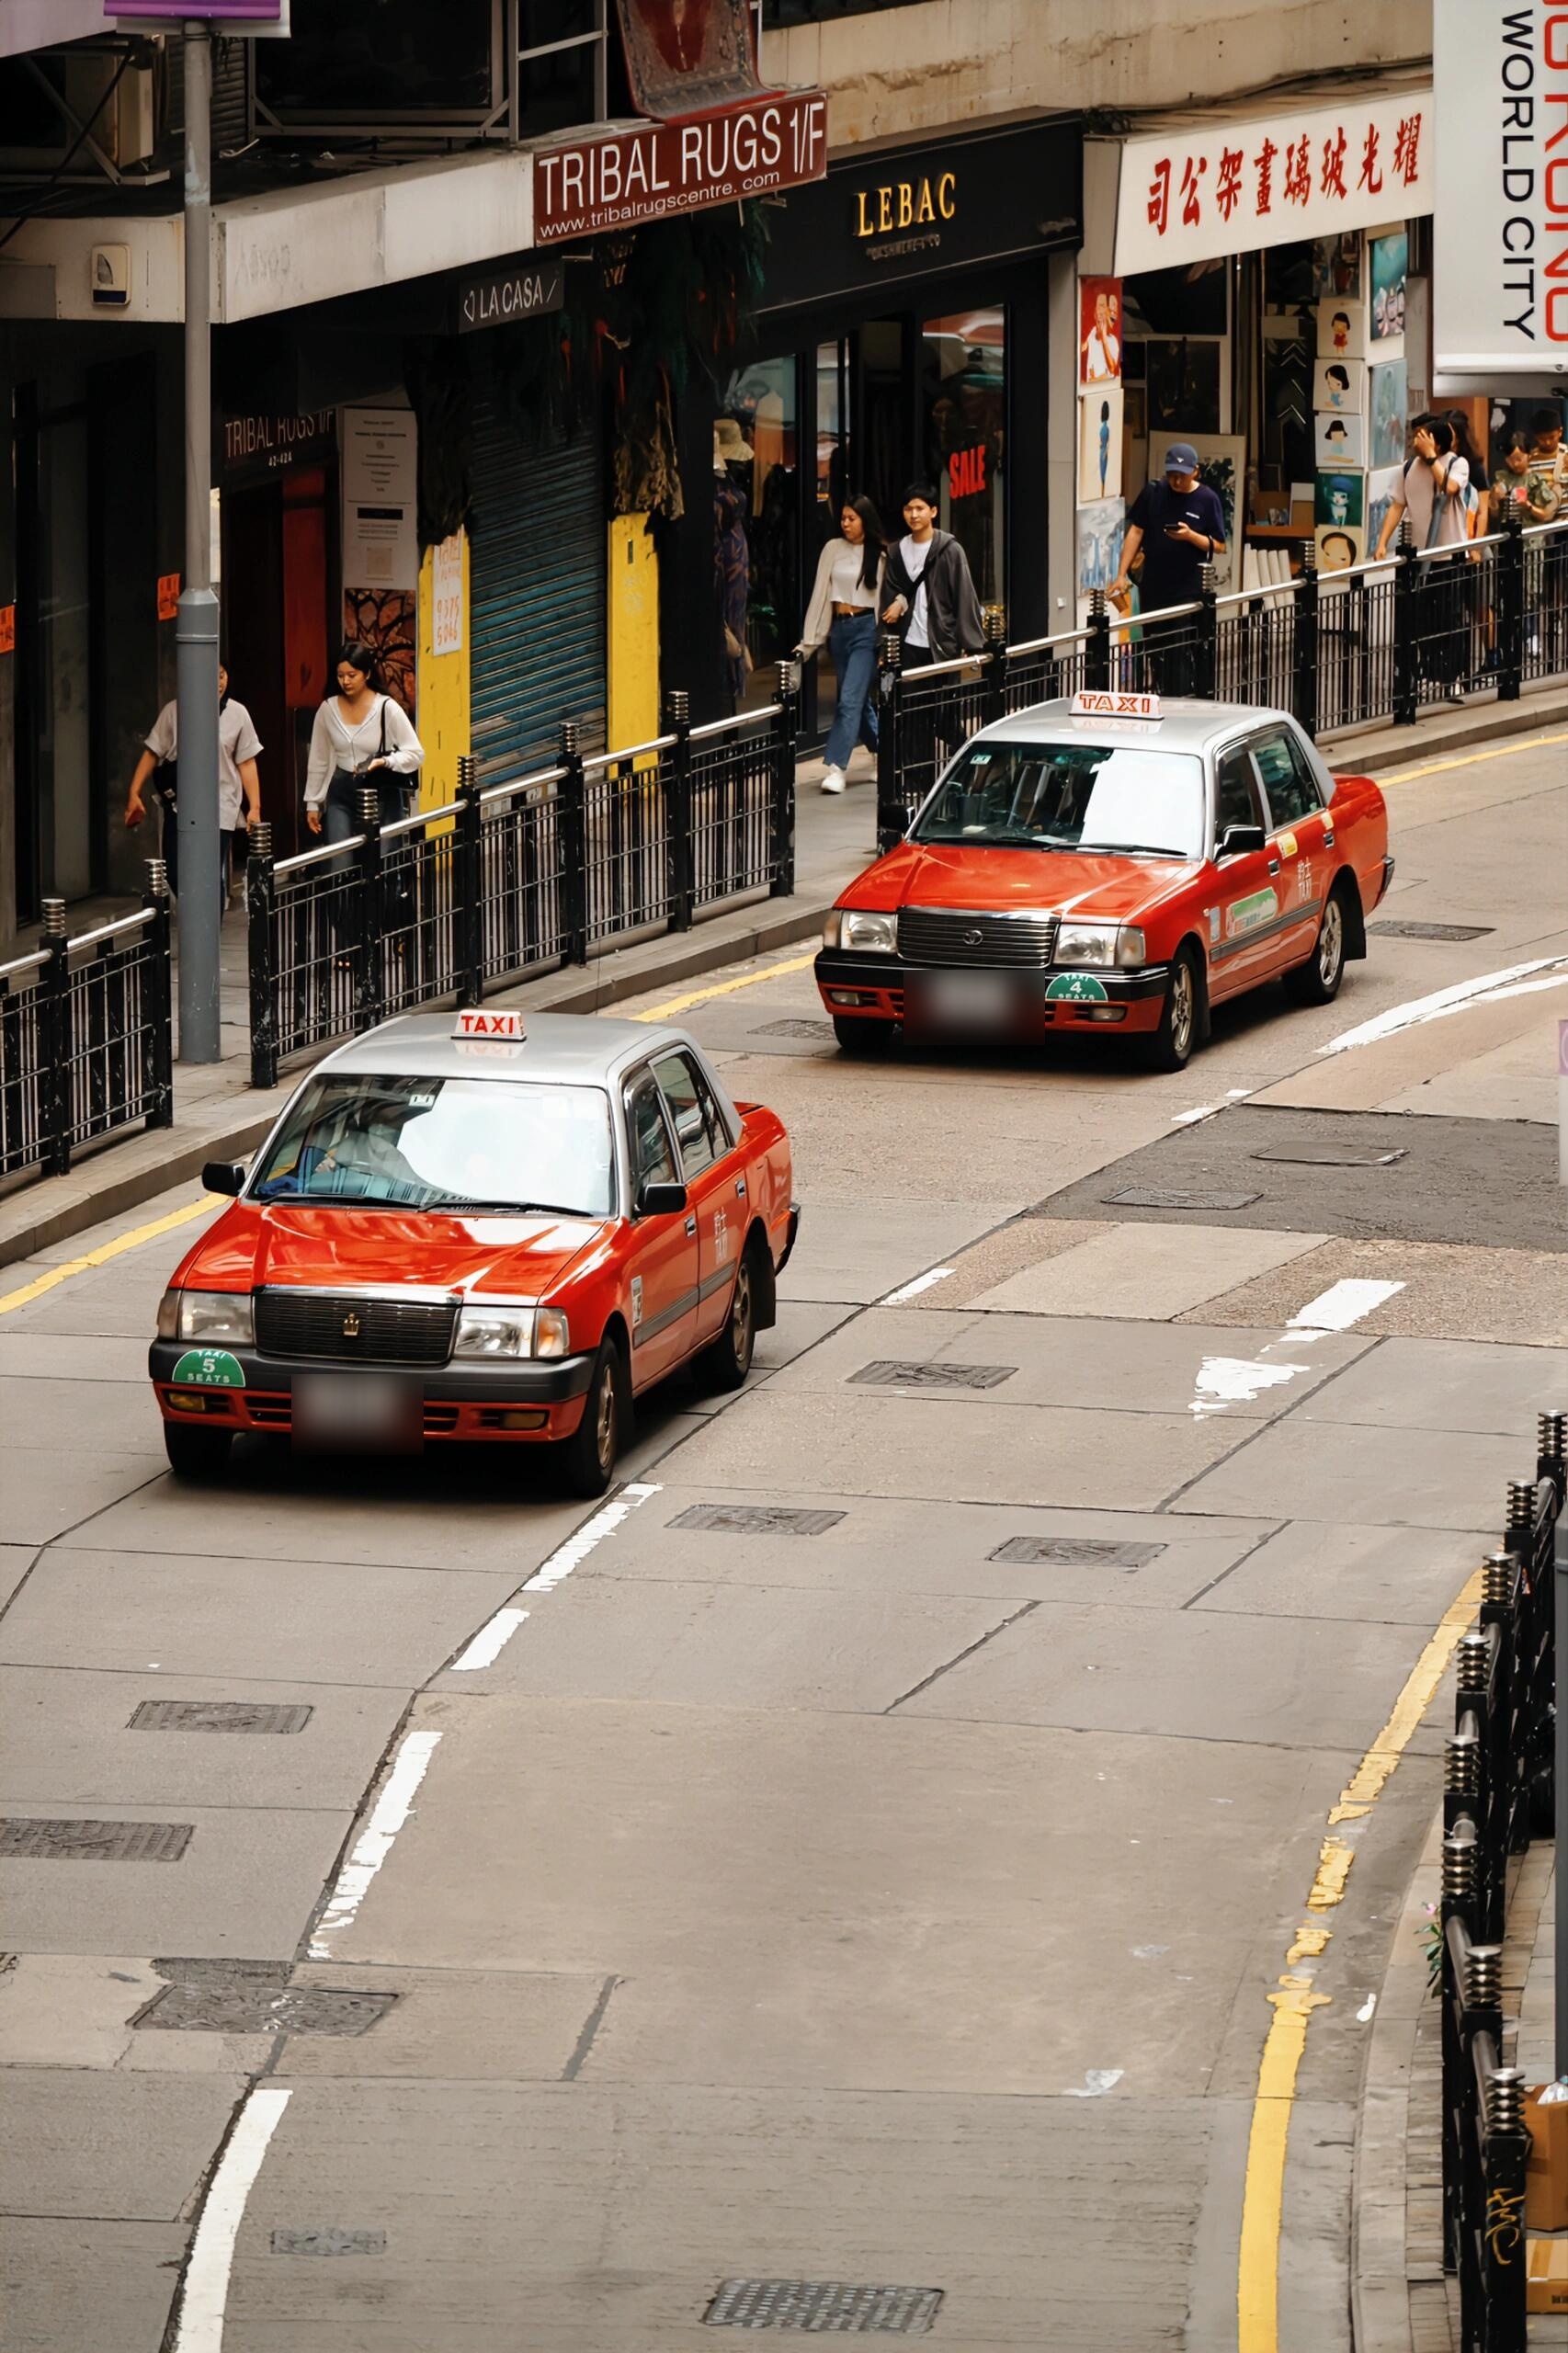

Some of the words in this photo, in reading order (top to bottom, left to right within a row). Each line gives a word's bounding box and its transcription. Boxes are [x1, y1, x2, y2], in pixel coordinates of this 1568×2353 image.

[1502, 9, 1534, 202] WORLD
[539, 135, 669, 215] TRIBAL
[681, 108, 781, 185] RUGS
[790, 102, 824, 175] 1/F
[857, 173, 956, 237] LEBAC
[1503, 217, 1535, 341] CITY
[480, 285, 499, 319] LA
[502, 275, 543, 313] CASA
[225, 415, 273, 458] TRIBAL
[949, 445, 986, 499] SALE
[1079, 694, 1151, 713] TAXI
[1063, 974, 1091, 983] TAXI
[1069, 981, 1083, 994] 4
[1058, 993, 1096, 1002] SEATS
[460, 1015, 514, 1034] TAXI
[197, 1350, 226, 1359] TAXI
[202, 1358, 216, 1373] 5
[187, 1373, 231, 1383] SEATS
